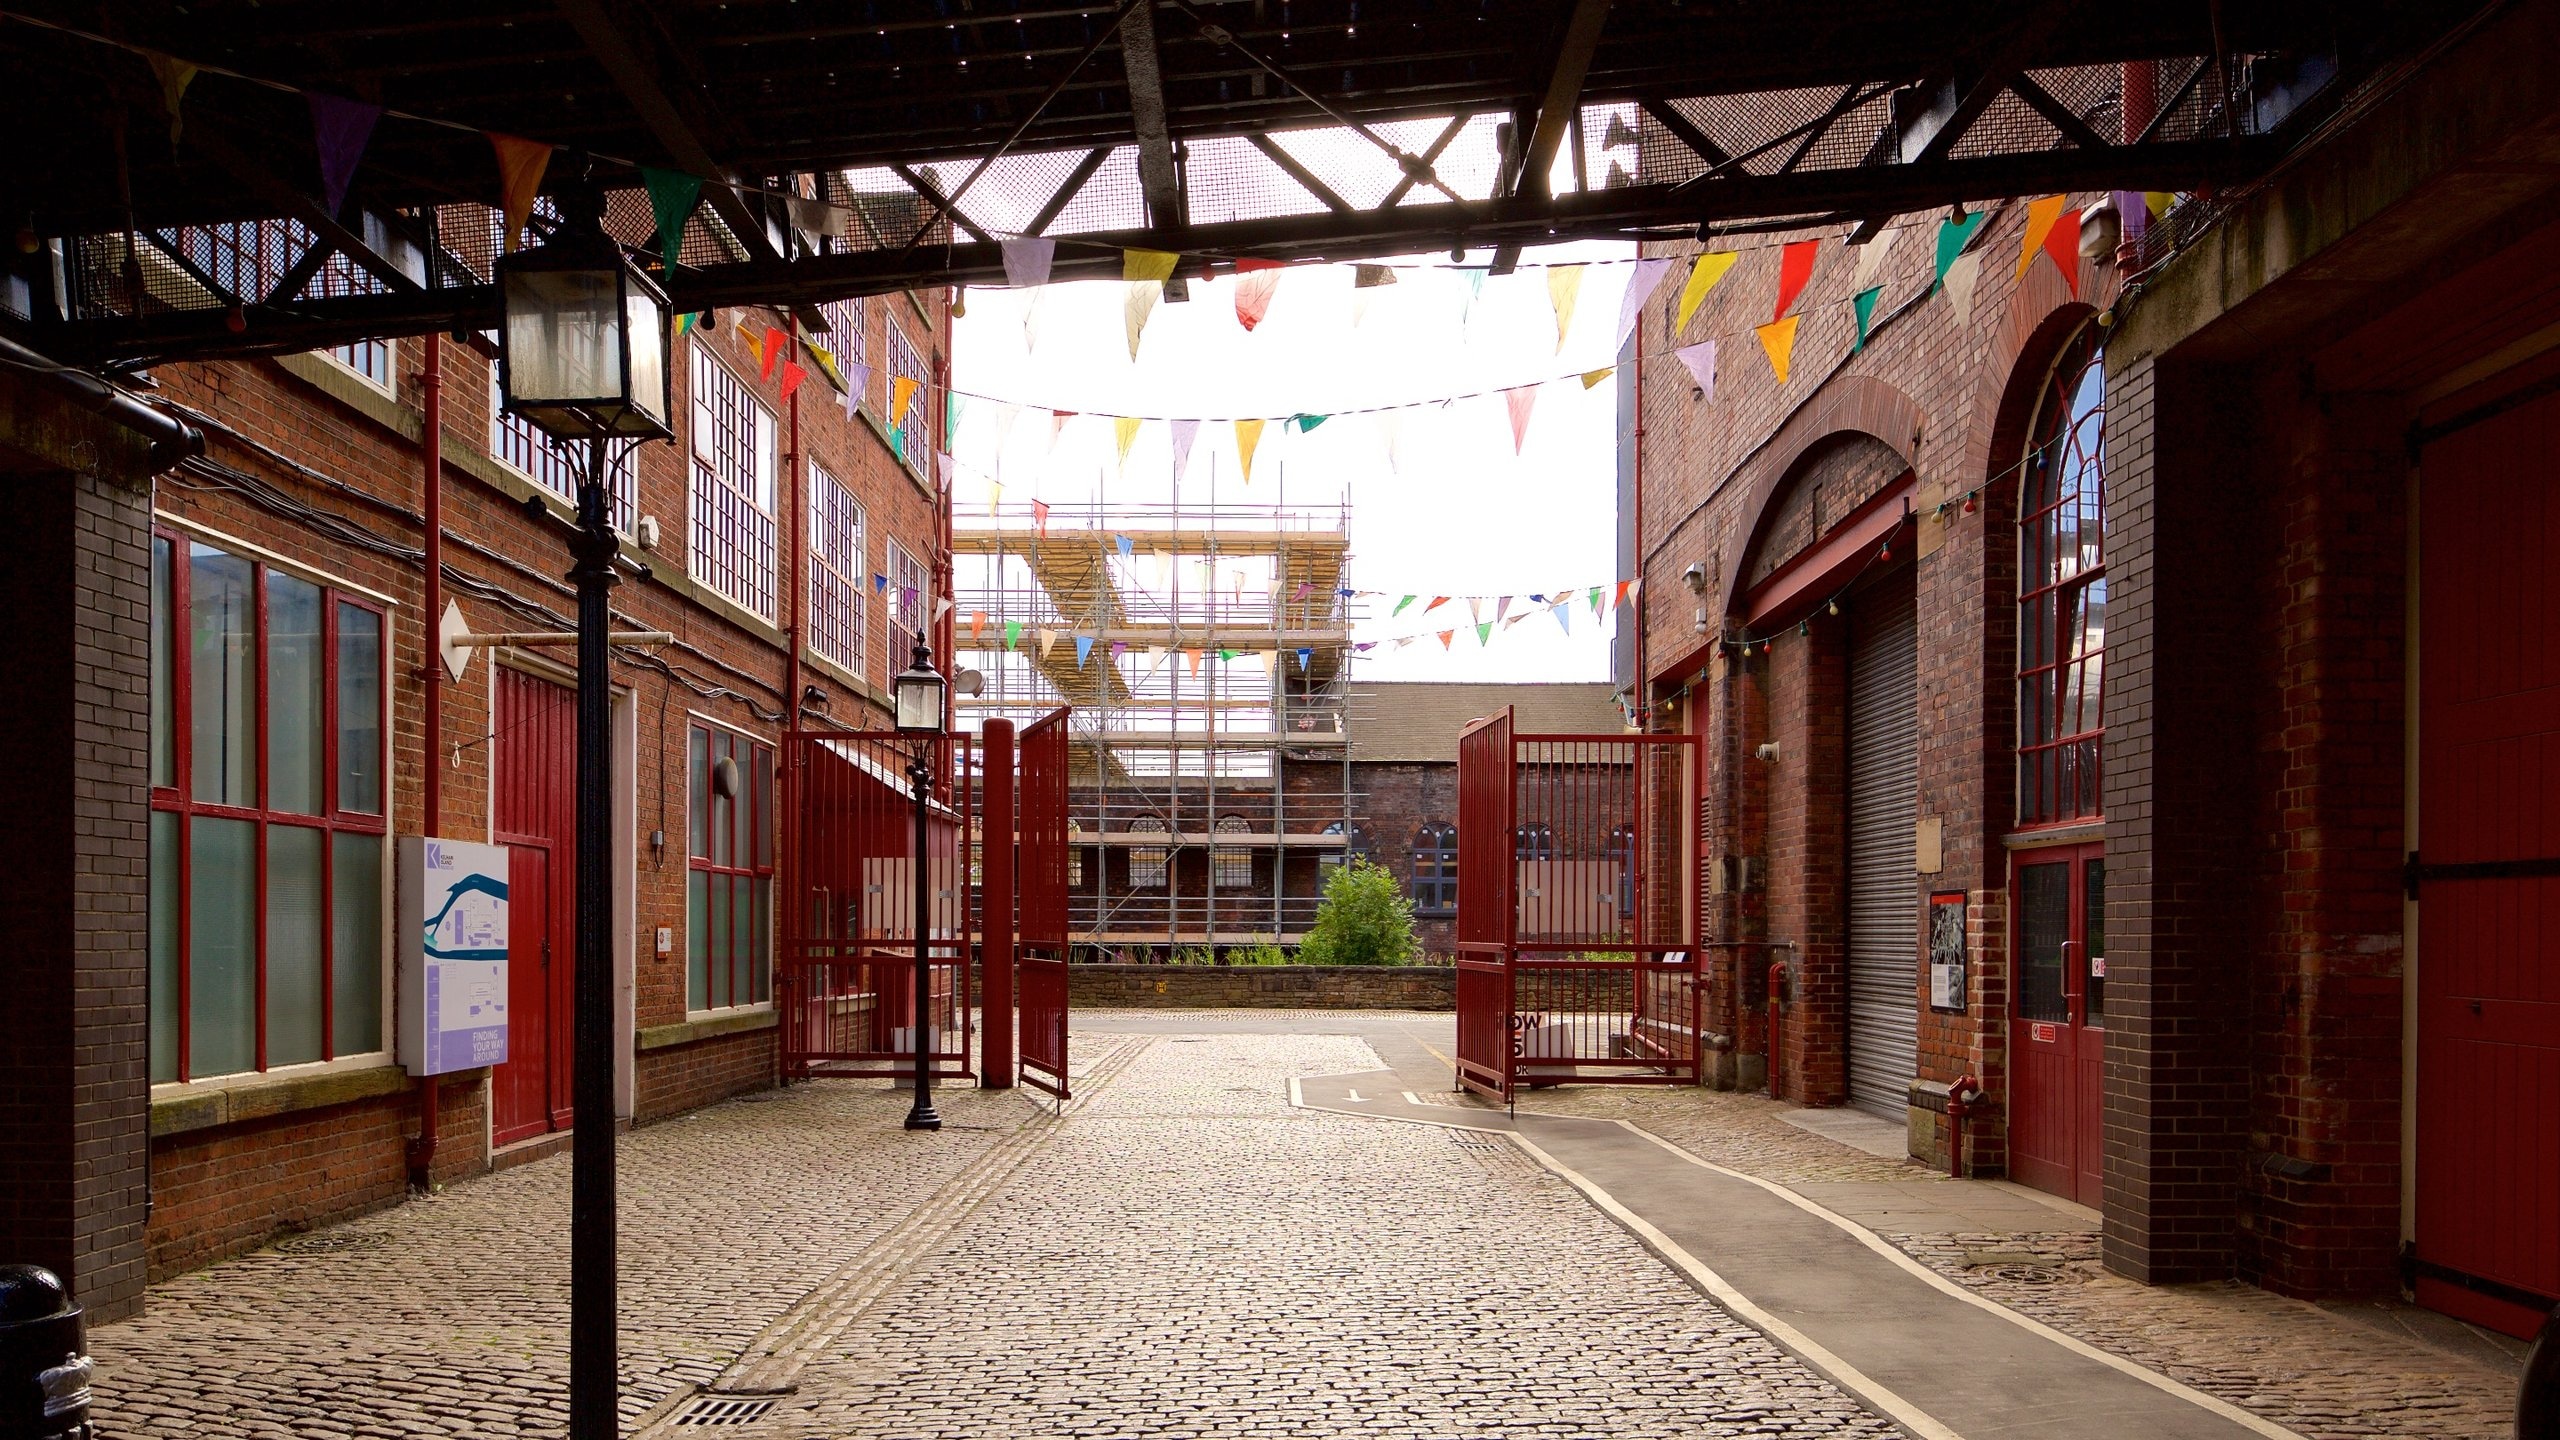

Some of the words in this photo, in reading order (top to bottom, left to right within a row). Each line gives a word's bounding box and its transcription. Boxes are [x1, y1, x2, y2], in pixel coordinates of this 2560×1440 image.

[473, 1030, 498, 1042] FINDING
[473, 1041, 490, 1052] YOUR
[491, 1039, 504, 1050] WAY
[473, 1050, 499, 1063] AROUND
